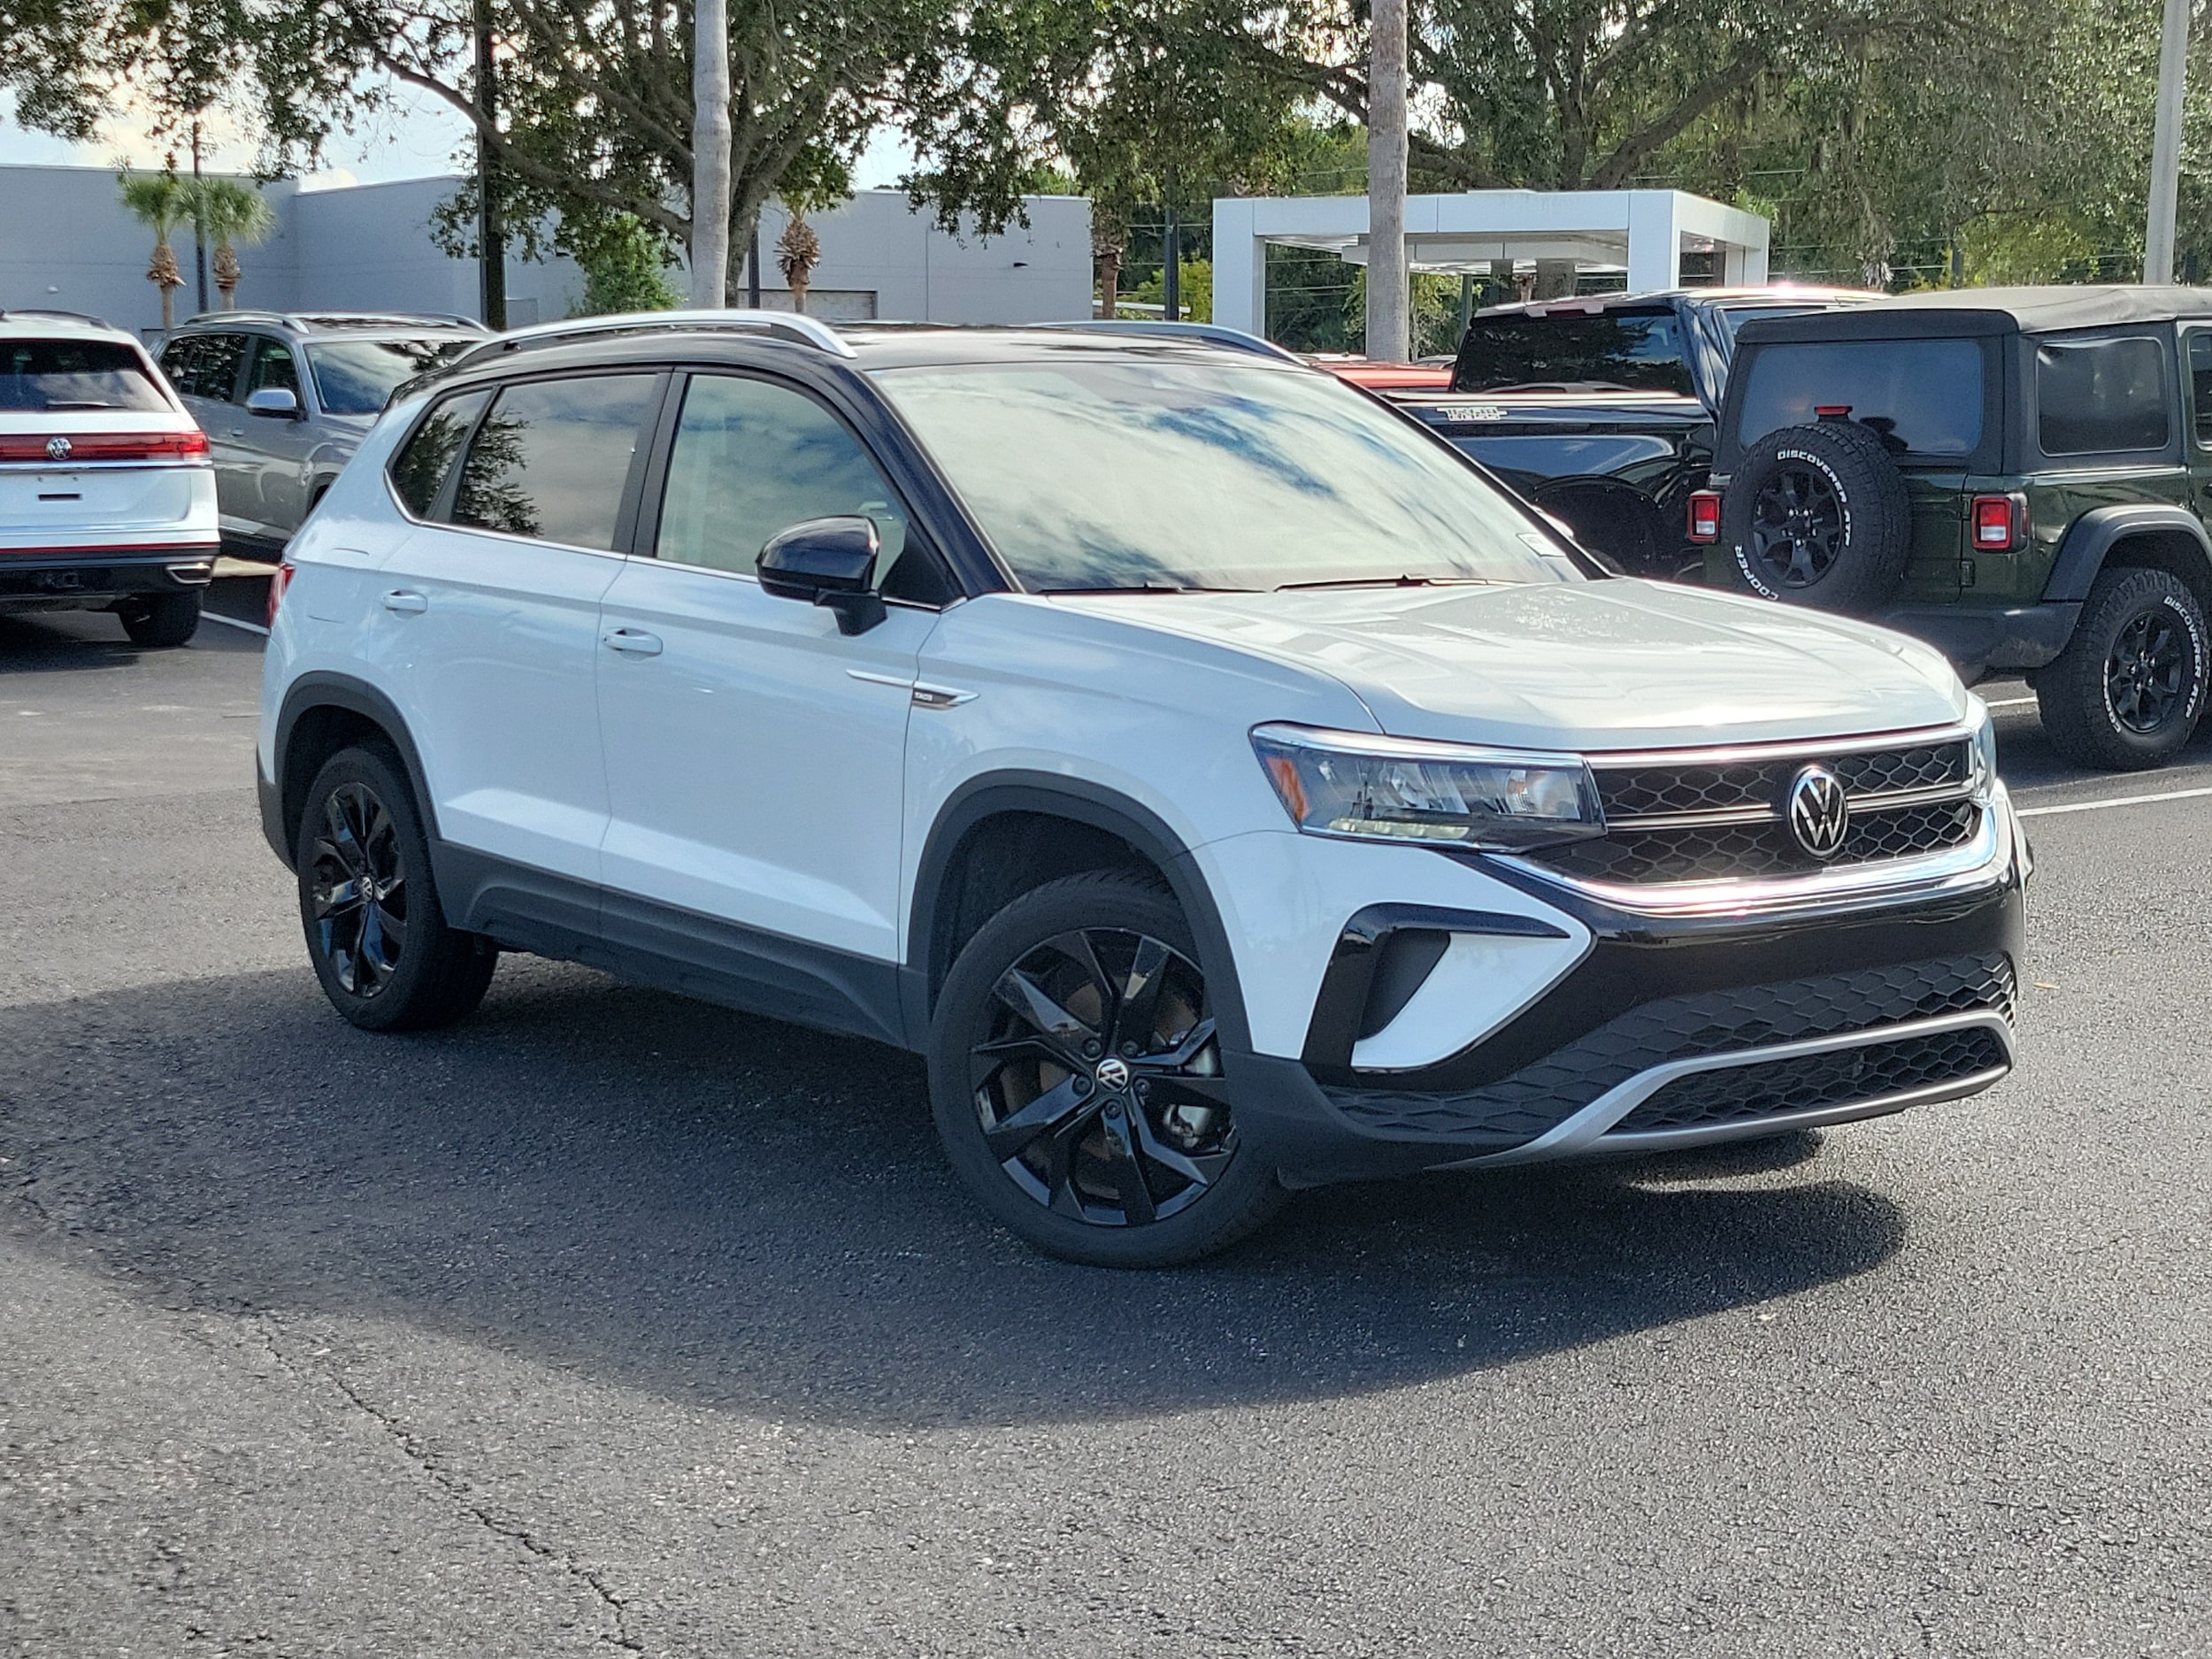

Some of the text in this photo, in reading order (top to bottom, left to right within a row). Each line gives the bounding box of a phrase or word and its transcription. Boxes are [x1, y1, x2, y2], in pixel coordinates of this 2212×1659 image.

[1777, 449, 1848, 503] DISCOVERER
[1734, 545, 1779, 602] COOPER
[2163, 595, 2202, 678] DISCOVERER
[1791, 766, 1847, 854] VW
